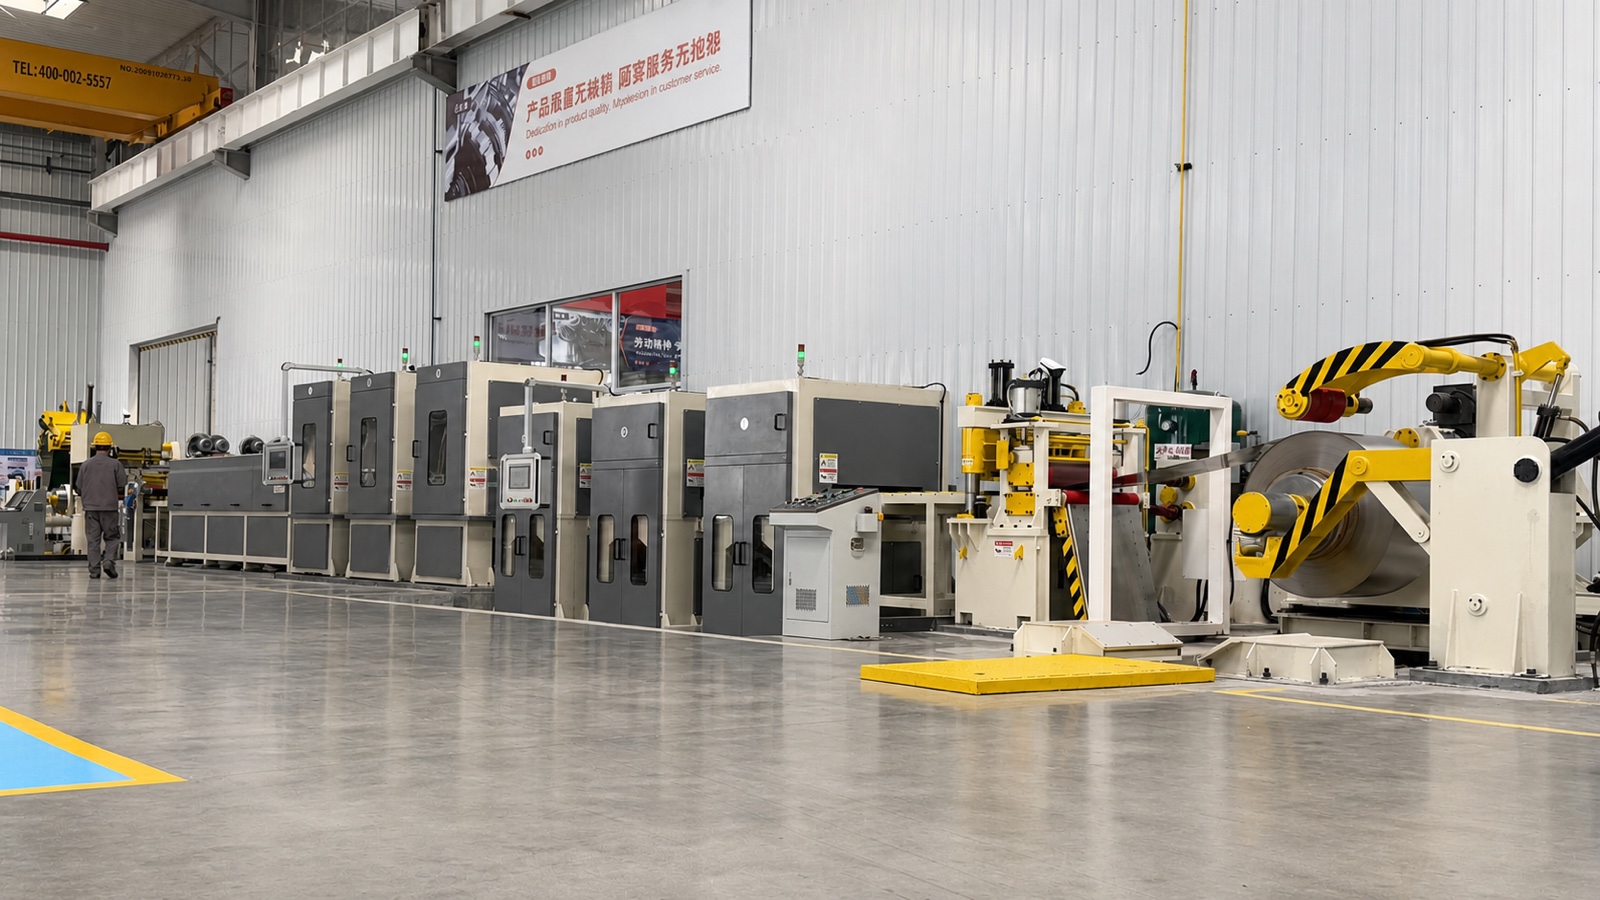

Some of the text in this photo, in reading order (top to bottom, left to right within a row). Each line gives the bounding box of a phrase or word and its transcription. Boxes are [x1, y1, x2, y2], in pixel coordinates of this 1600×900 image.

[12, 59, 112, 89] TEL:400-002-5557
[564, 109, 588, 128] product
[650, 85, 657, 96] in
[658, 73, 693, 93] customer
